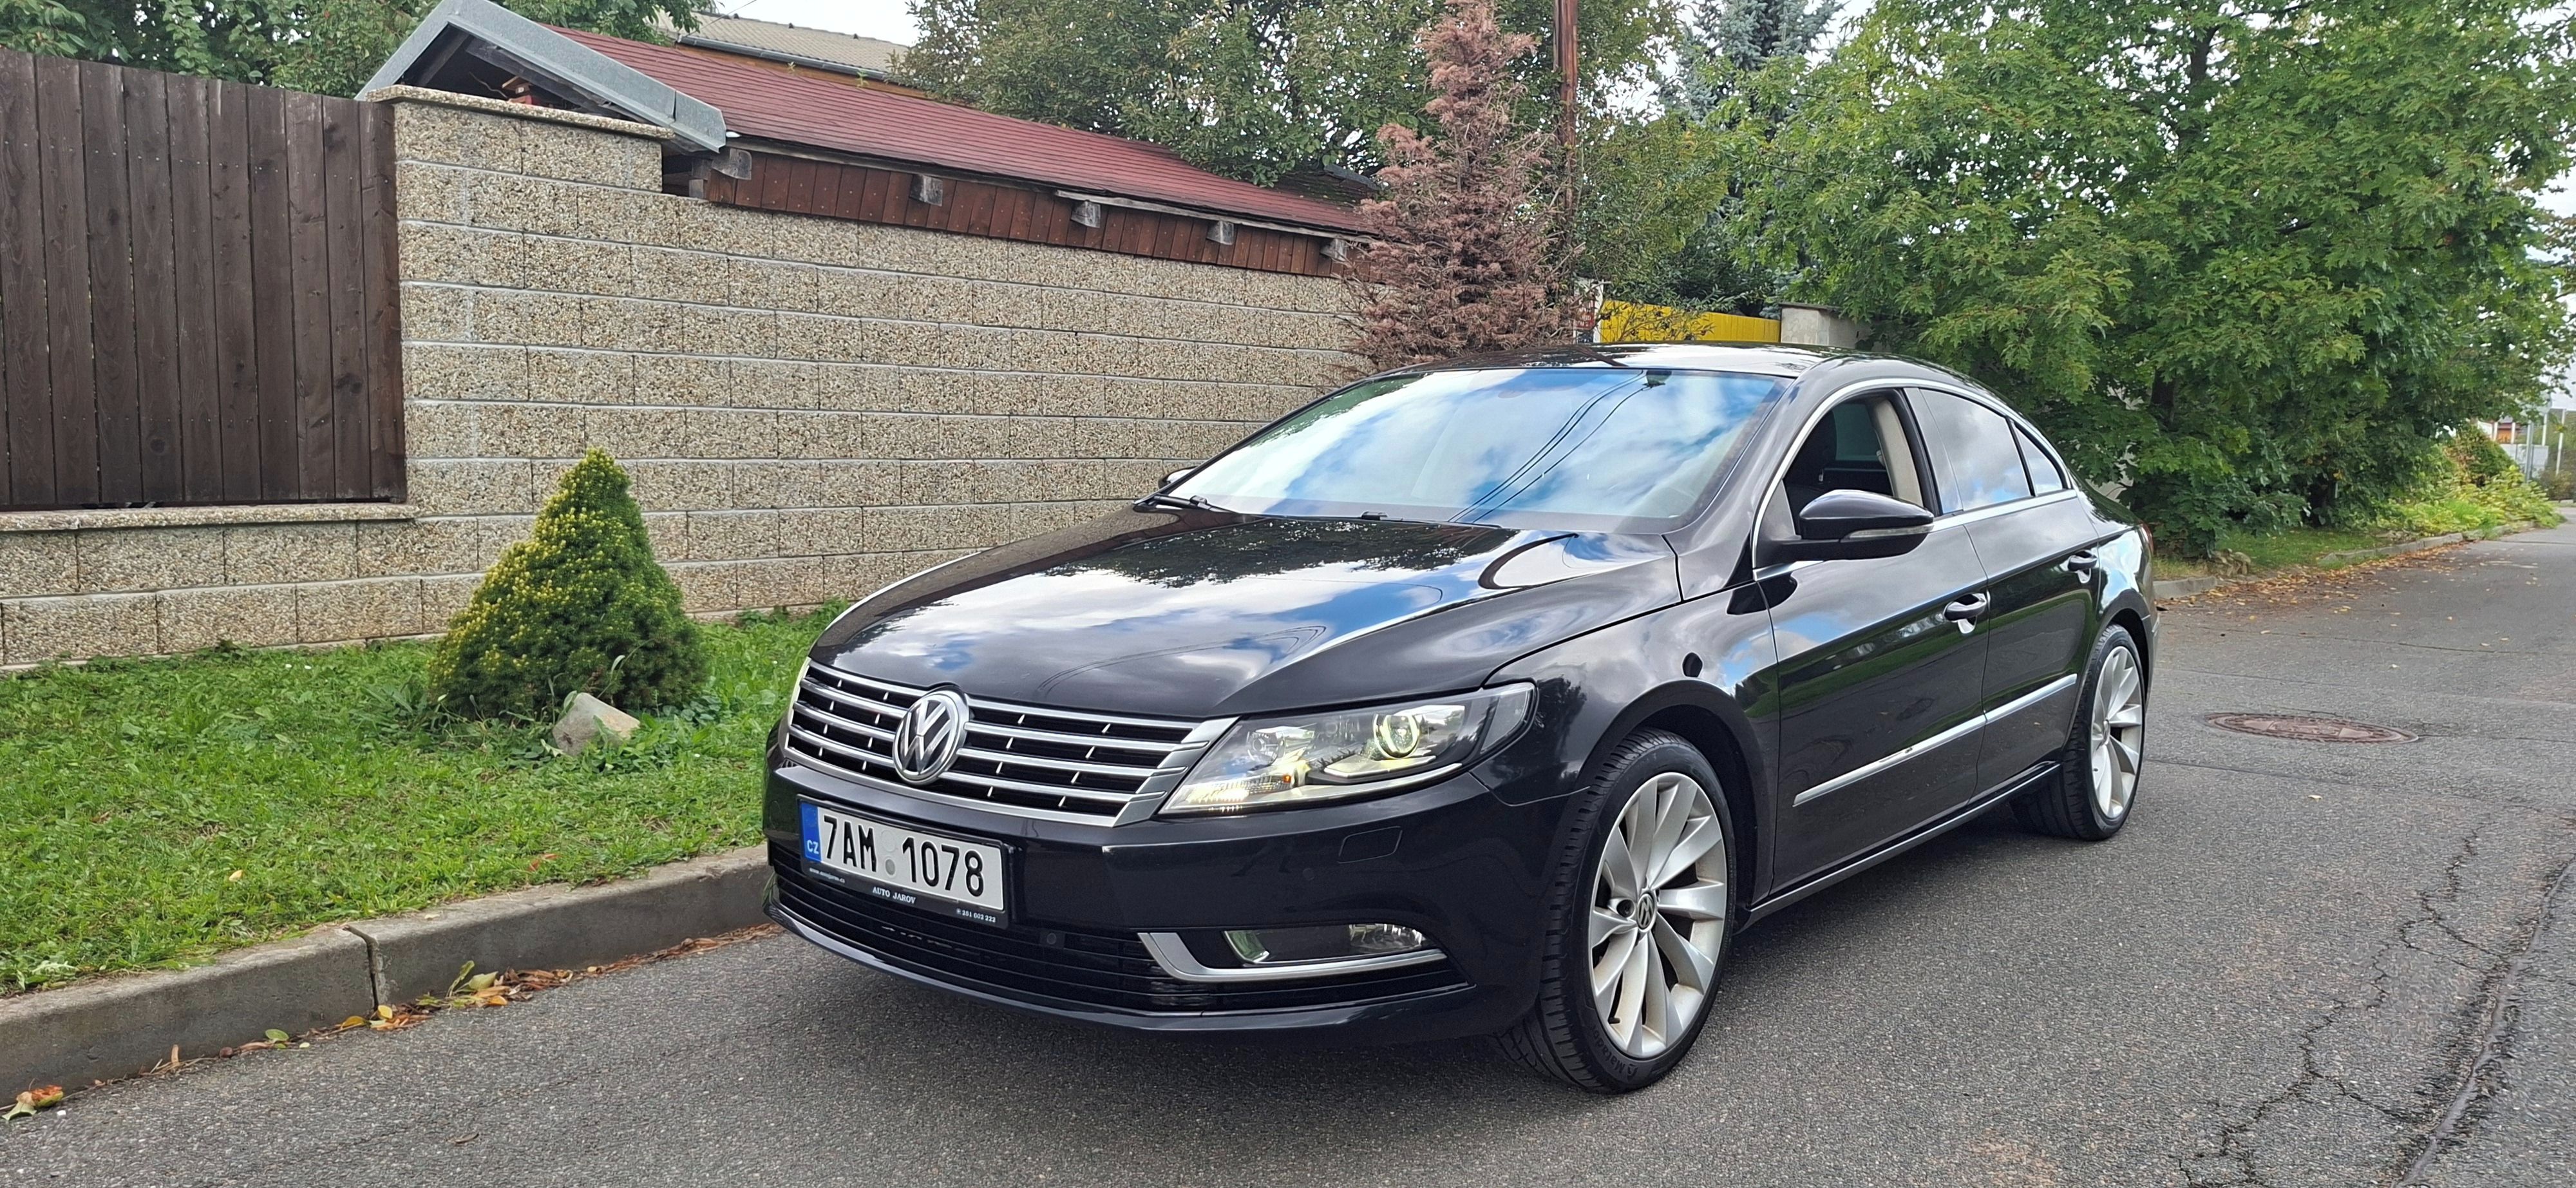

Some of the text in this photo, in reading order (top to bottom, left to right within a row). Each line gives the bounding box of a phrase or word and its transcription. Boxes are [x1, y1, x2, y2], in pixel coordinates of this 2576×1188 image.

[807, 839, 819, 854] CZ
[824, 815, 983, 897] 7AM 1078
[872, 886, 916, 904] AUTO JAROV
